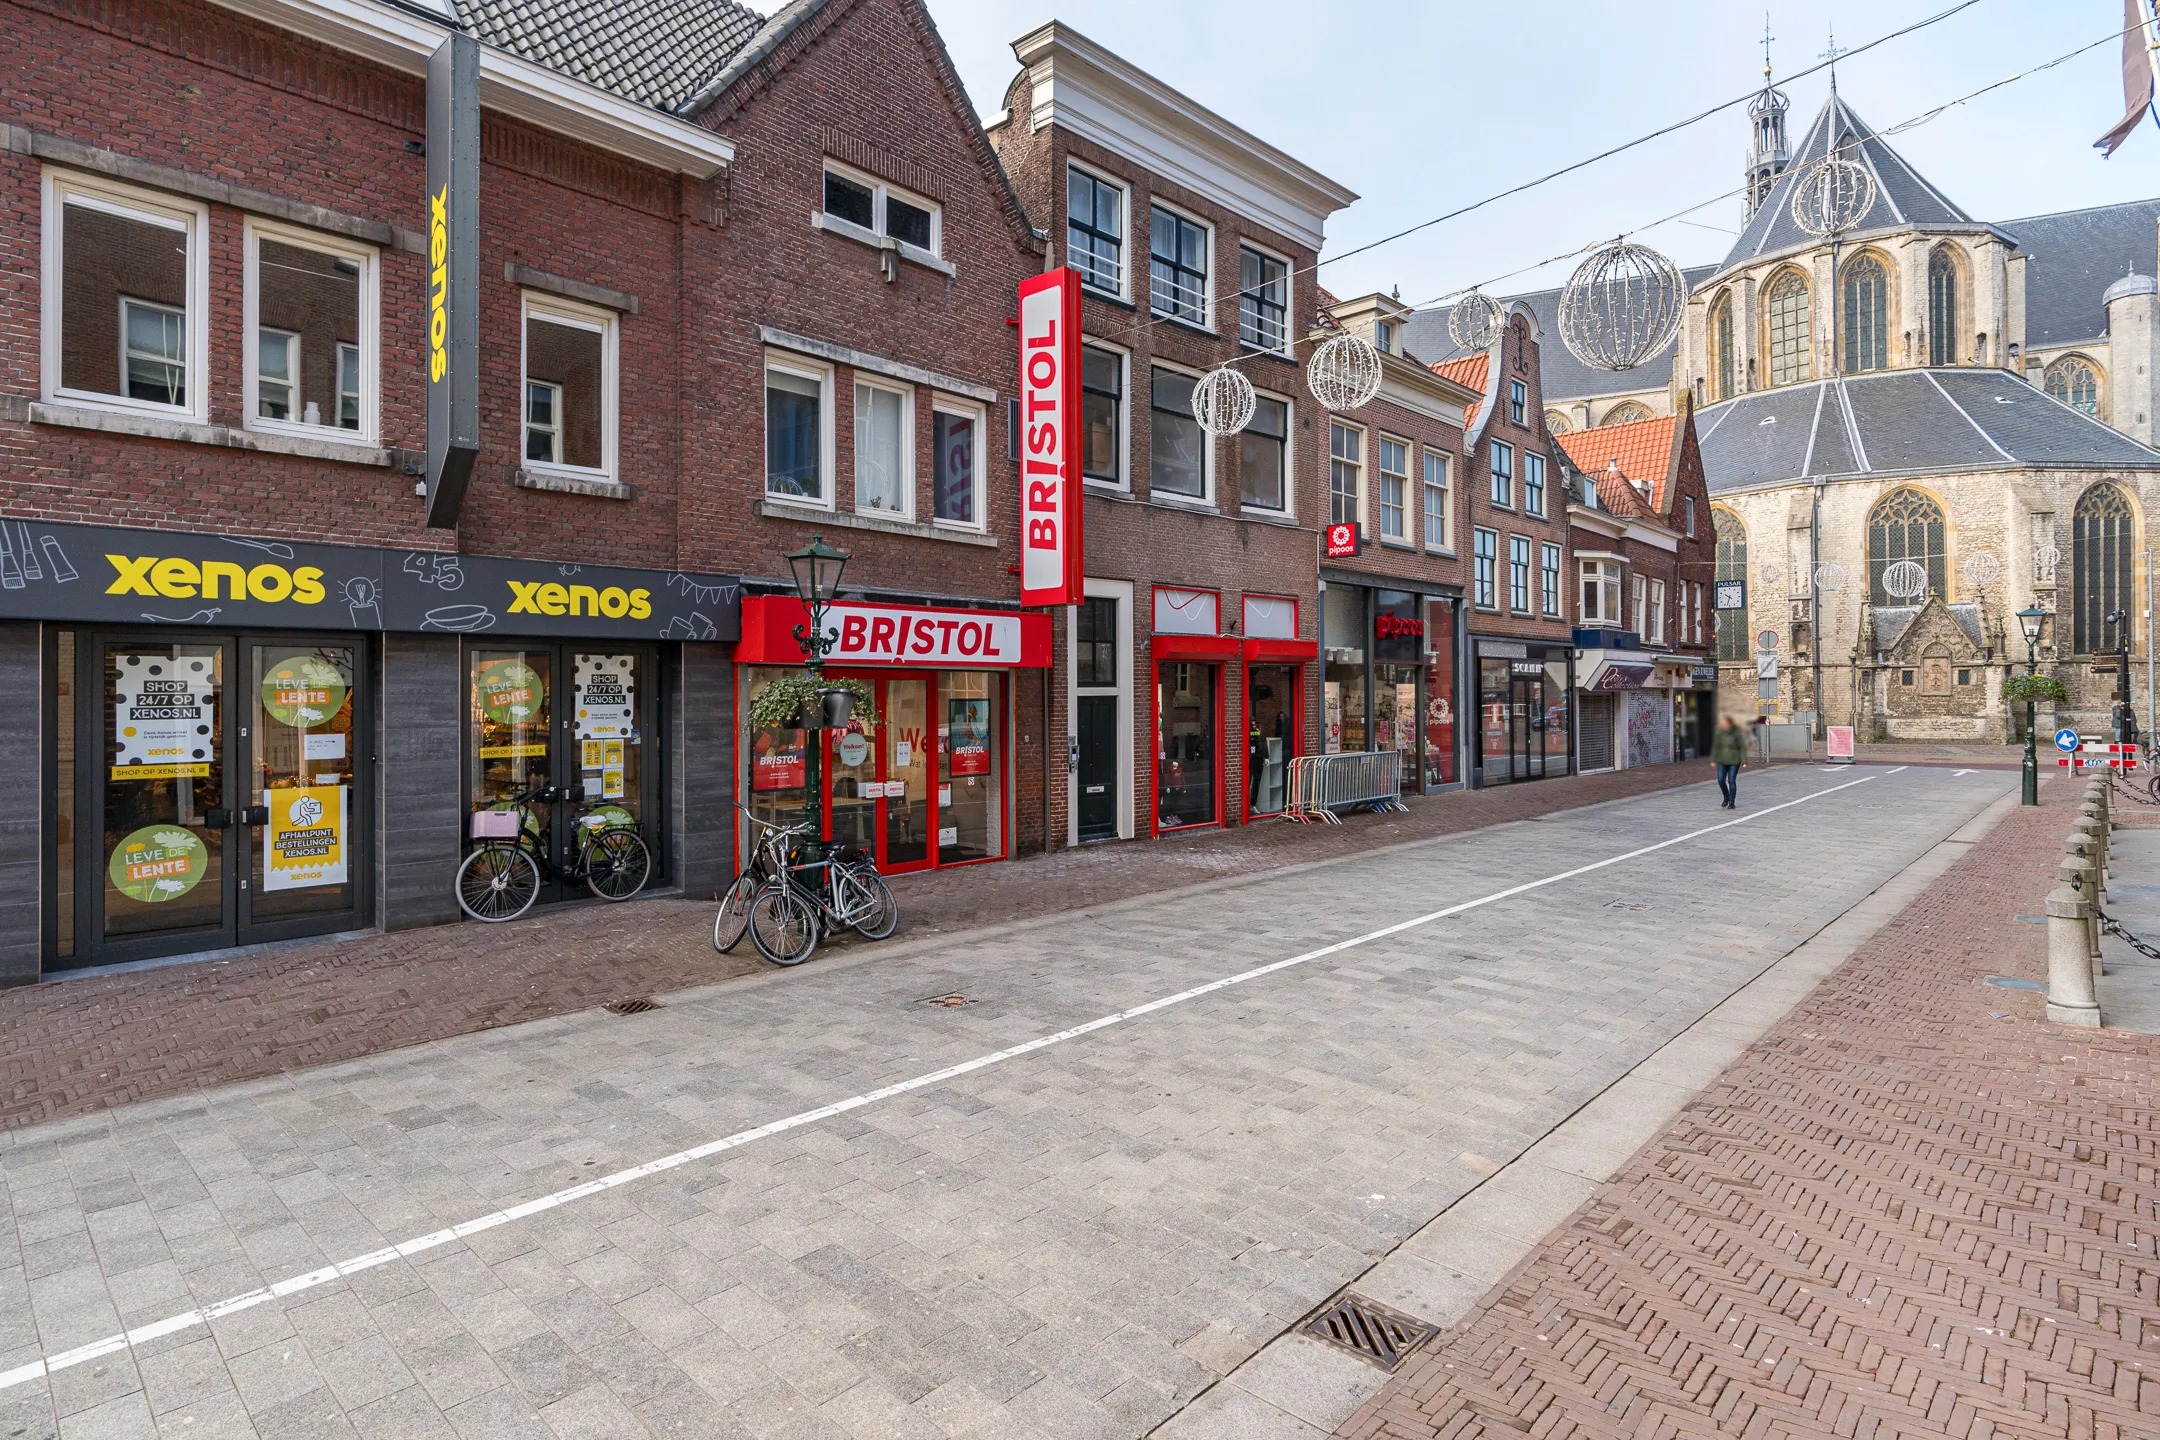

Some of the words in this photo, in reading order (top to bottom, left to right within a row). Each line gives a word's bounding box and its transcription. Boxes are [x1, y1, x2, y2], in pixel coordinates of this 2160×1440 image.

[431, 183, 447, 383] xenos
[1027, 319, 1057, 551] BRISTOL
[1328, 546, 1354, 556] pipoos
[104, 554, 326, 604] xenos
[506, 580, 652, 620] xenos
[840, 615, 1000, 657] BRISTOL
[275, 679, 309, 690] LEVE
[592, 675, 617, 683] SHOP
[146, 681, 185, 692] SHOP
[486, 681, 513, 694] LEVE
[588, 685, 607, 694] 24/7
[608, 685, 621, 693] OP
[138, 695, 169, 705] 24/7
[172, 695, 193, 705] OP
[281, 691, 326, 703] LENTE
[493, 689, 529, 705] LENTE
[584, 695, 625, 704] XENOS.NL
[132, 708, 199, 719] XENOS.NL
[1429, 718, 1450, 726] pipoos
[147, 747, 185, 756] xenos
[955, 746, 985, 756] BRISTOL
[760, 755, 799, 767] BRISTOL
[116, 769, 141, 777] SHOP
[158, 767, 197, 775] XENOS.NL
[280, 828, 332, 840] AFHAALPUNT
[275, 837, 336, 849] BESTELLINGEN
[125, 849, 164, 865] LEVE
[168, 847, 186, 857] DE
[284, 847, 328, 858] XENOS.NL
[133, 860, 186, 879] LENTE
[290, 871, 323, 881] xenos
